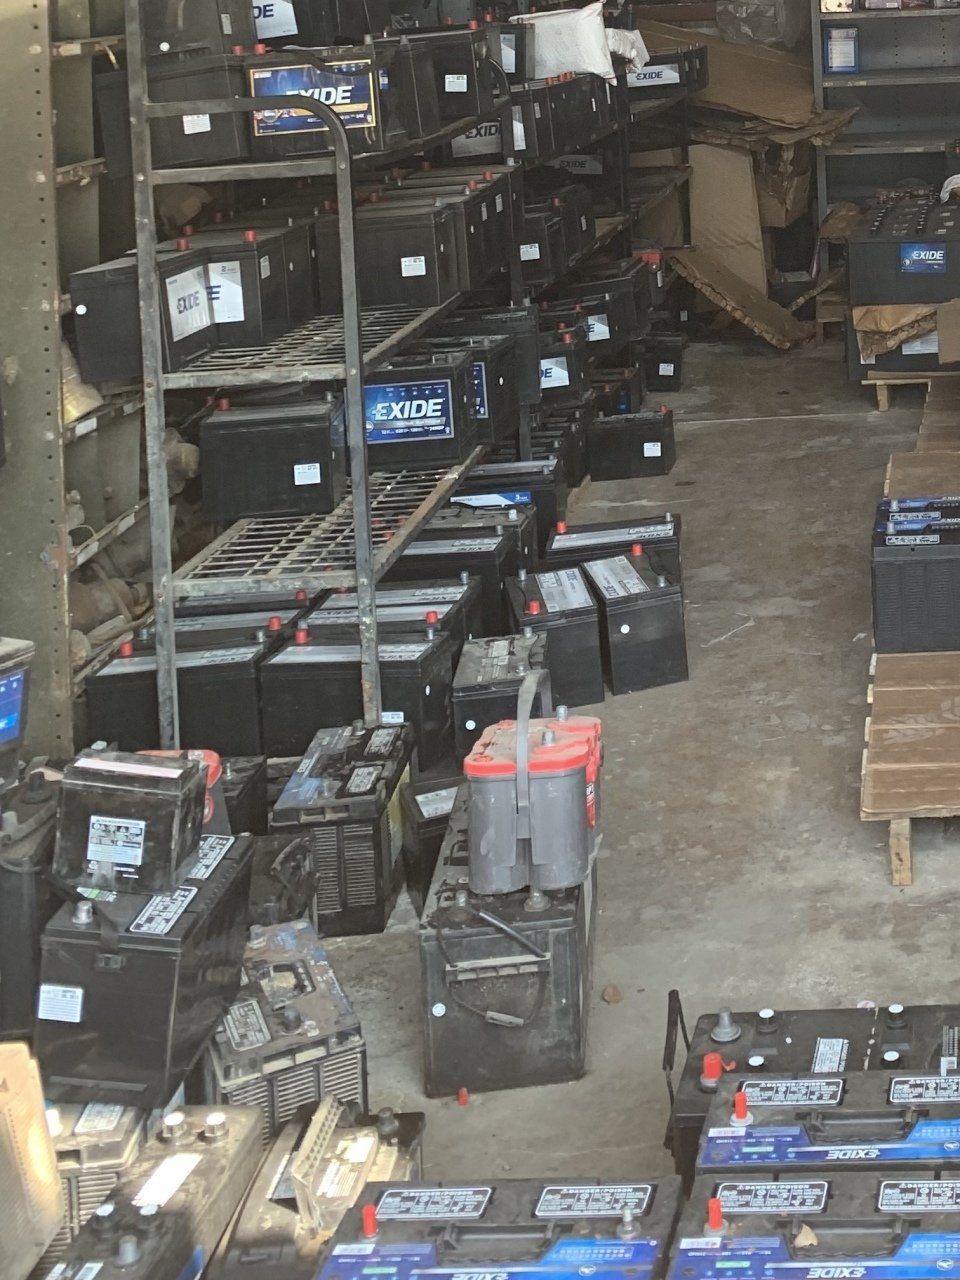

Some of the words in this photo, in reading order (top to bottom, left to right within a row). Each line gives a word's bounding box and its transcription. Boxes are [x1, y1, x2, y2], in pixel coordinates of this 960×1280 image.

[636, 70, 663, 81] EXIDE
[286, 85, 354, 105] XIDE
[911, 250, 944, 260] EXIDE
[176, 291, 200, 314] EXIDE
[371, 398, 445, 421] EXIDE
[827, 1150, 881, 1159] EXIDE
[807, 1267, 866, 1279] EXIDE
